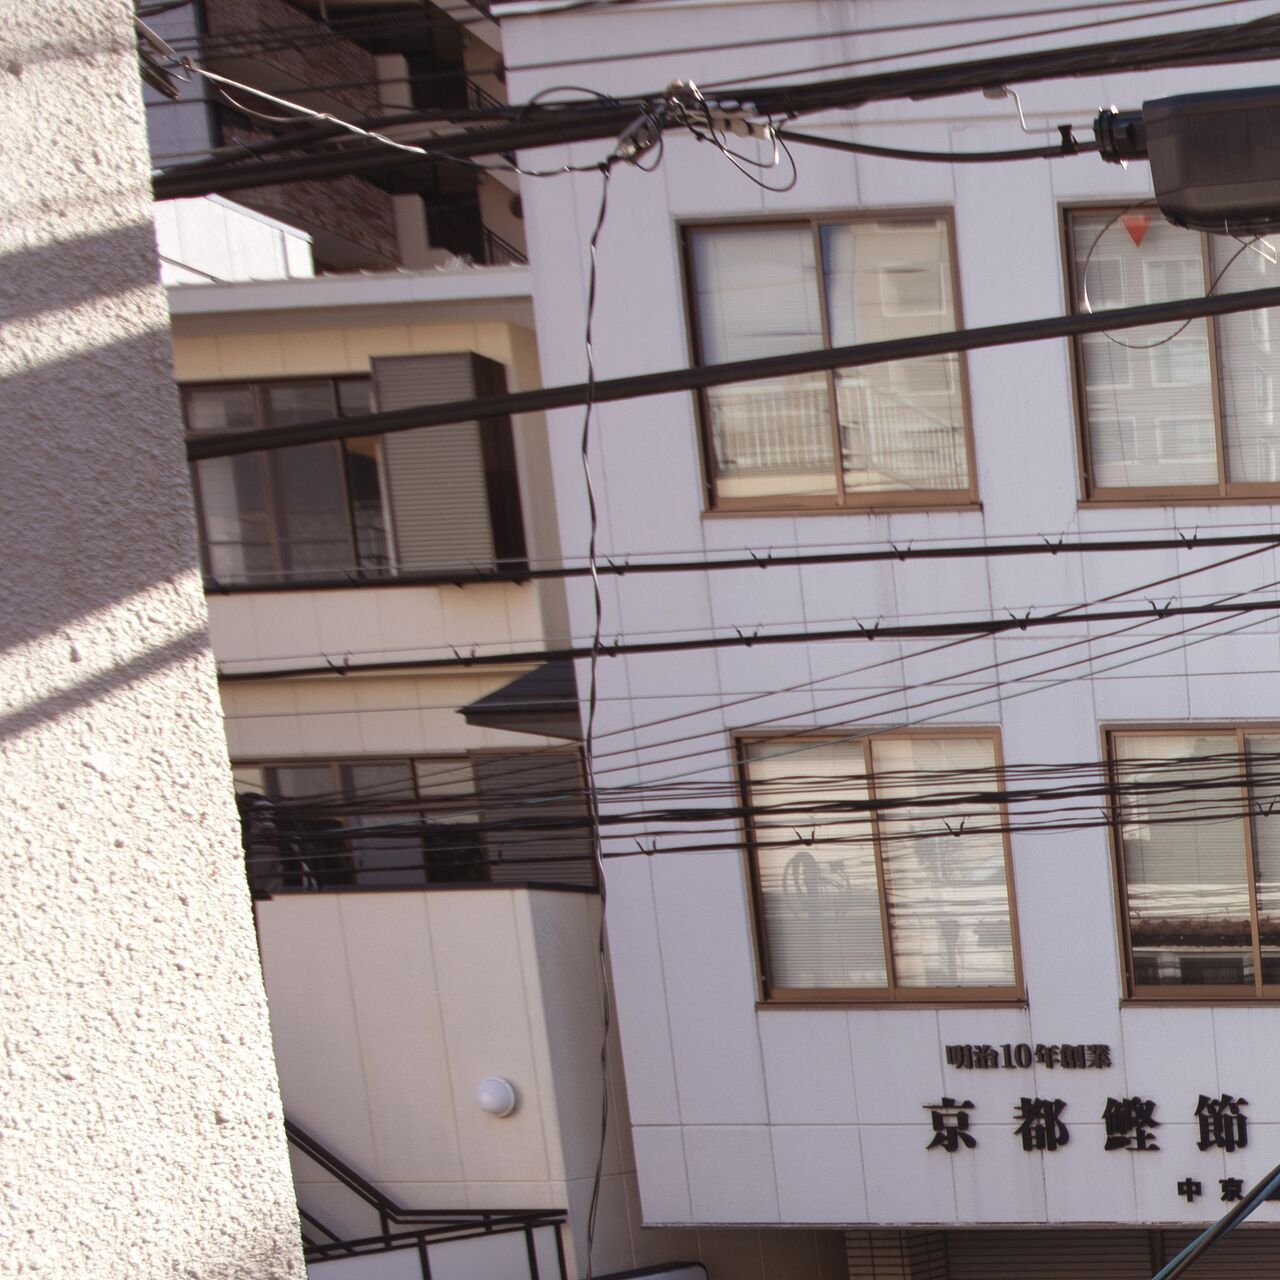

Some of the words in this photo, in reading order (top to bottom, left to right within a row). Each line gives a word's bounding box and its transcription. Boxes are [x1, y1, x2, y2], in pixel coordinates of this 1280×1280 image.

[945, 1043, 1112, 1069] 明治10年創業
